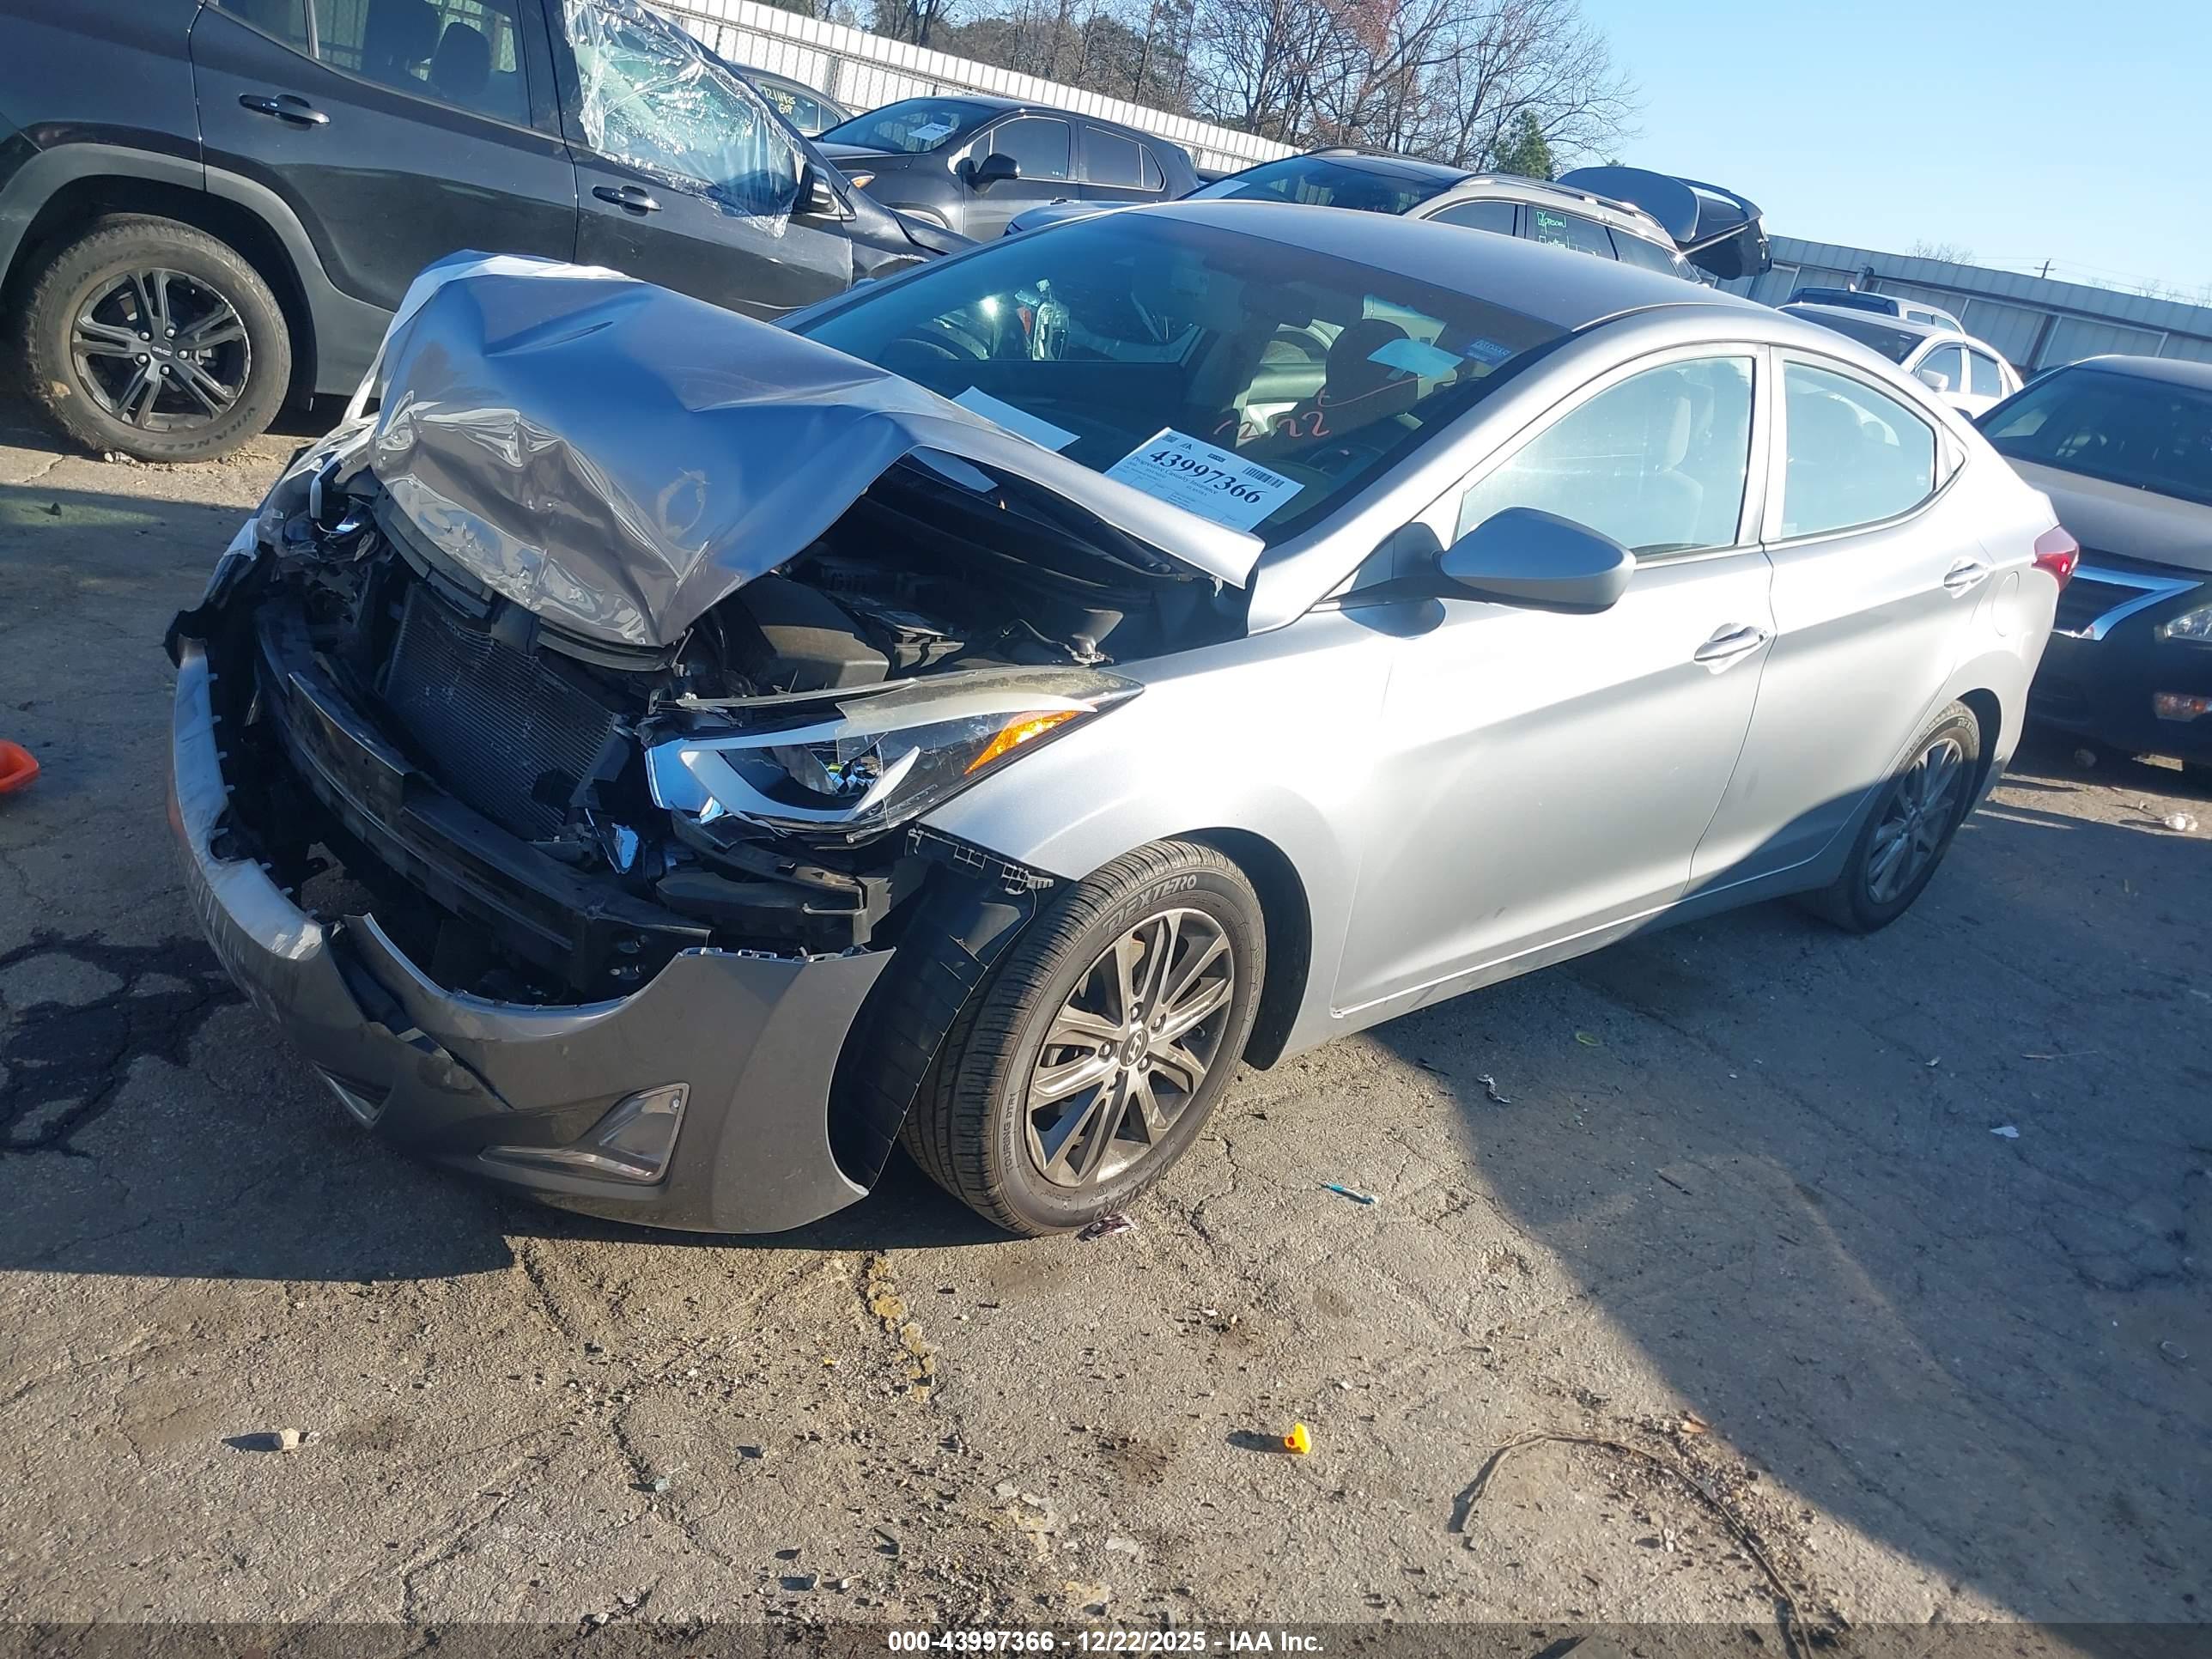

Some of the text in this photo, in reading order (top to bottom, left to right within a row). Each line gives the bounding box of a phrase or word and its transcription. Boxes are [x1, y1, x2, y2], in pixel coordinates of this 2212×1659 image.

[151, 346, 173, 357] GMC
[1149, 450, 1267, 504] 43997366
[1102, 874, 1198, 936] DEXTERO
[1003, 1125, 1016, 1174] TOURING
